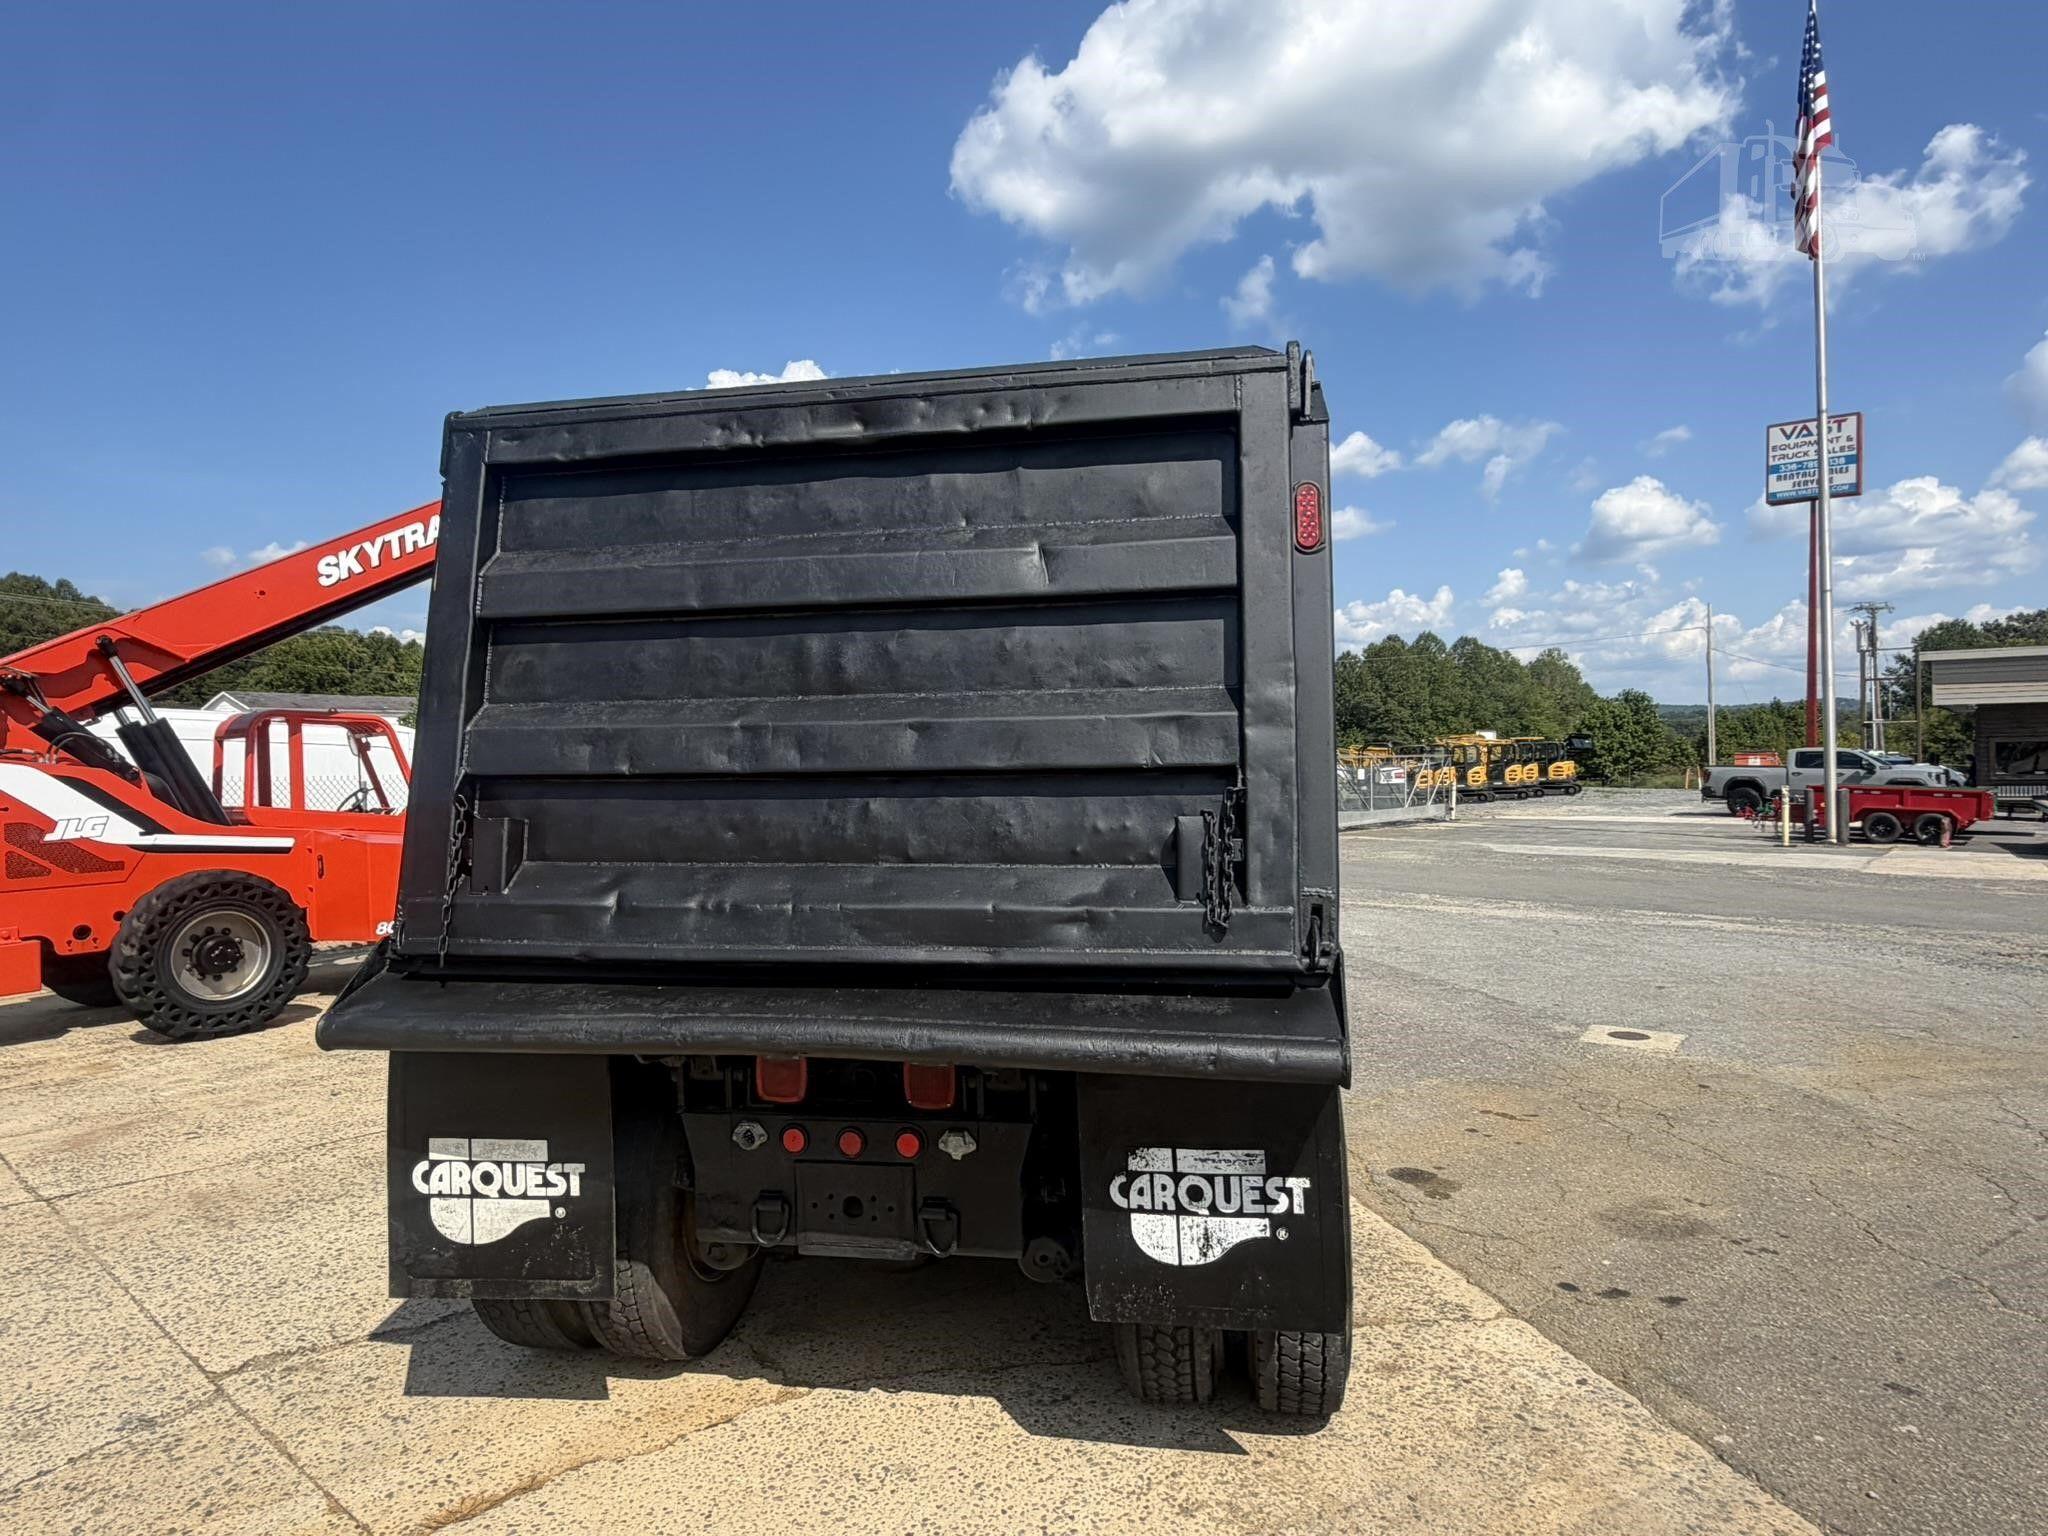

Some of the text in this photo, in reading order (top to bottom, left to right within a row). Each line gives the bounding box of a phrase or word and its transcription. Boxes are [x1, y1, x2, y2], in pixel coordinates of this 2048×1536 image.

[1771, 435, 1842, 452] EQUIPMNT
[1771, 445, 1856, 462] TRUCK LES
[1791, 476, 1834, 488] SERVE
[316, 513, 440, 588] SKYTRA
[40, 815, 110, 844] JLG
[412, 1160, 586, 1198] CARQUEST
[1109, 1171, 1311, 1216] CARQUEST
